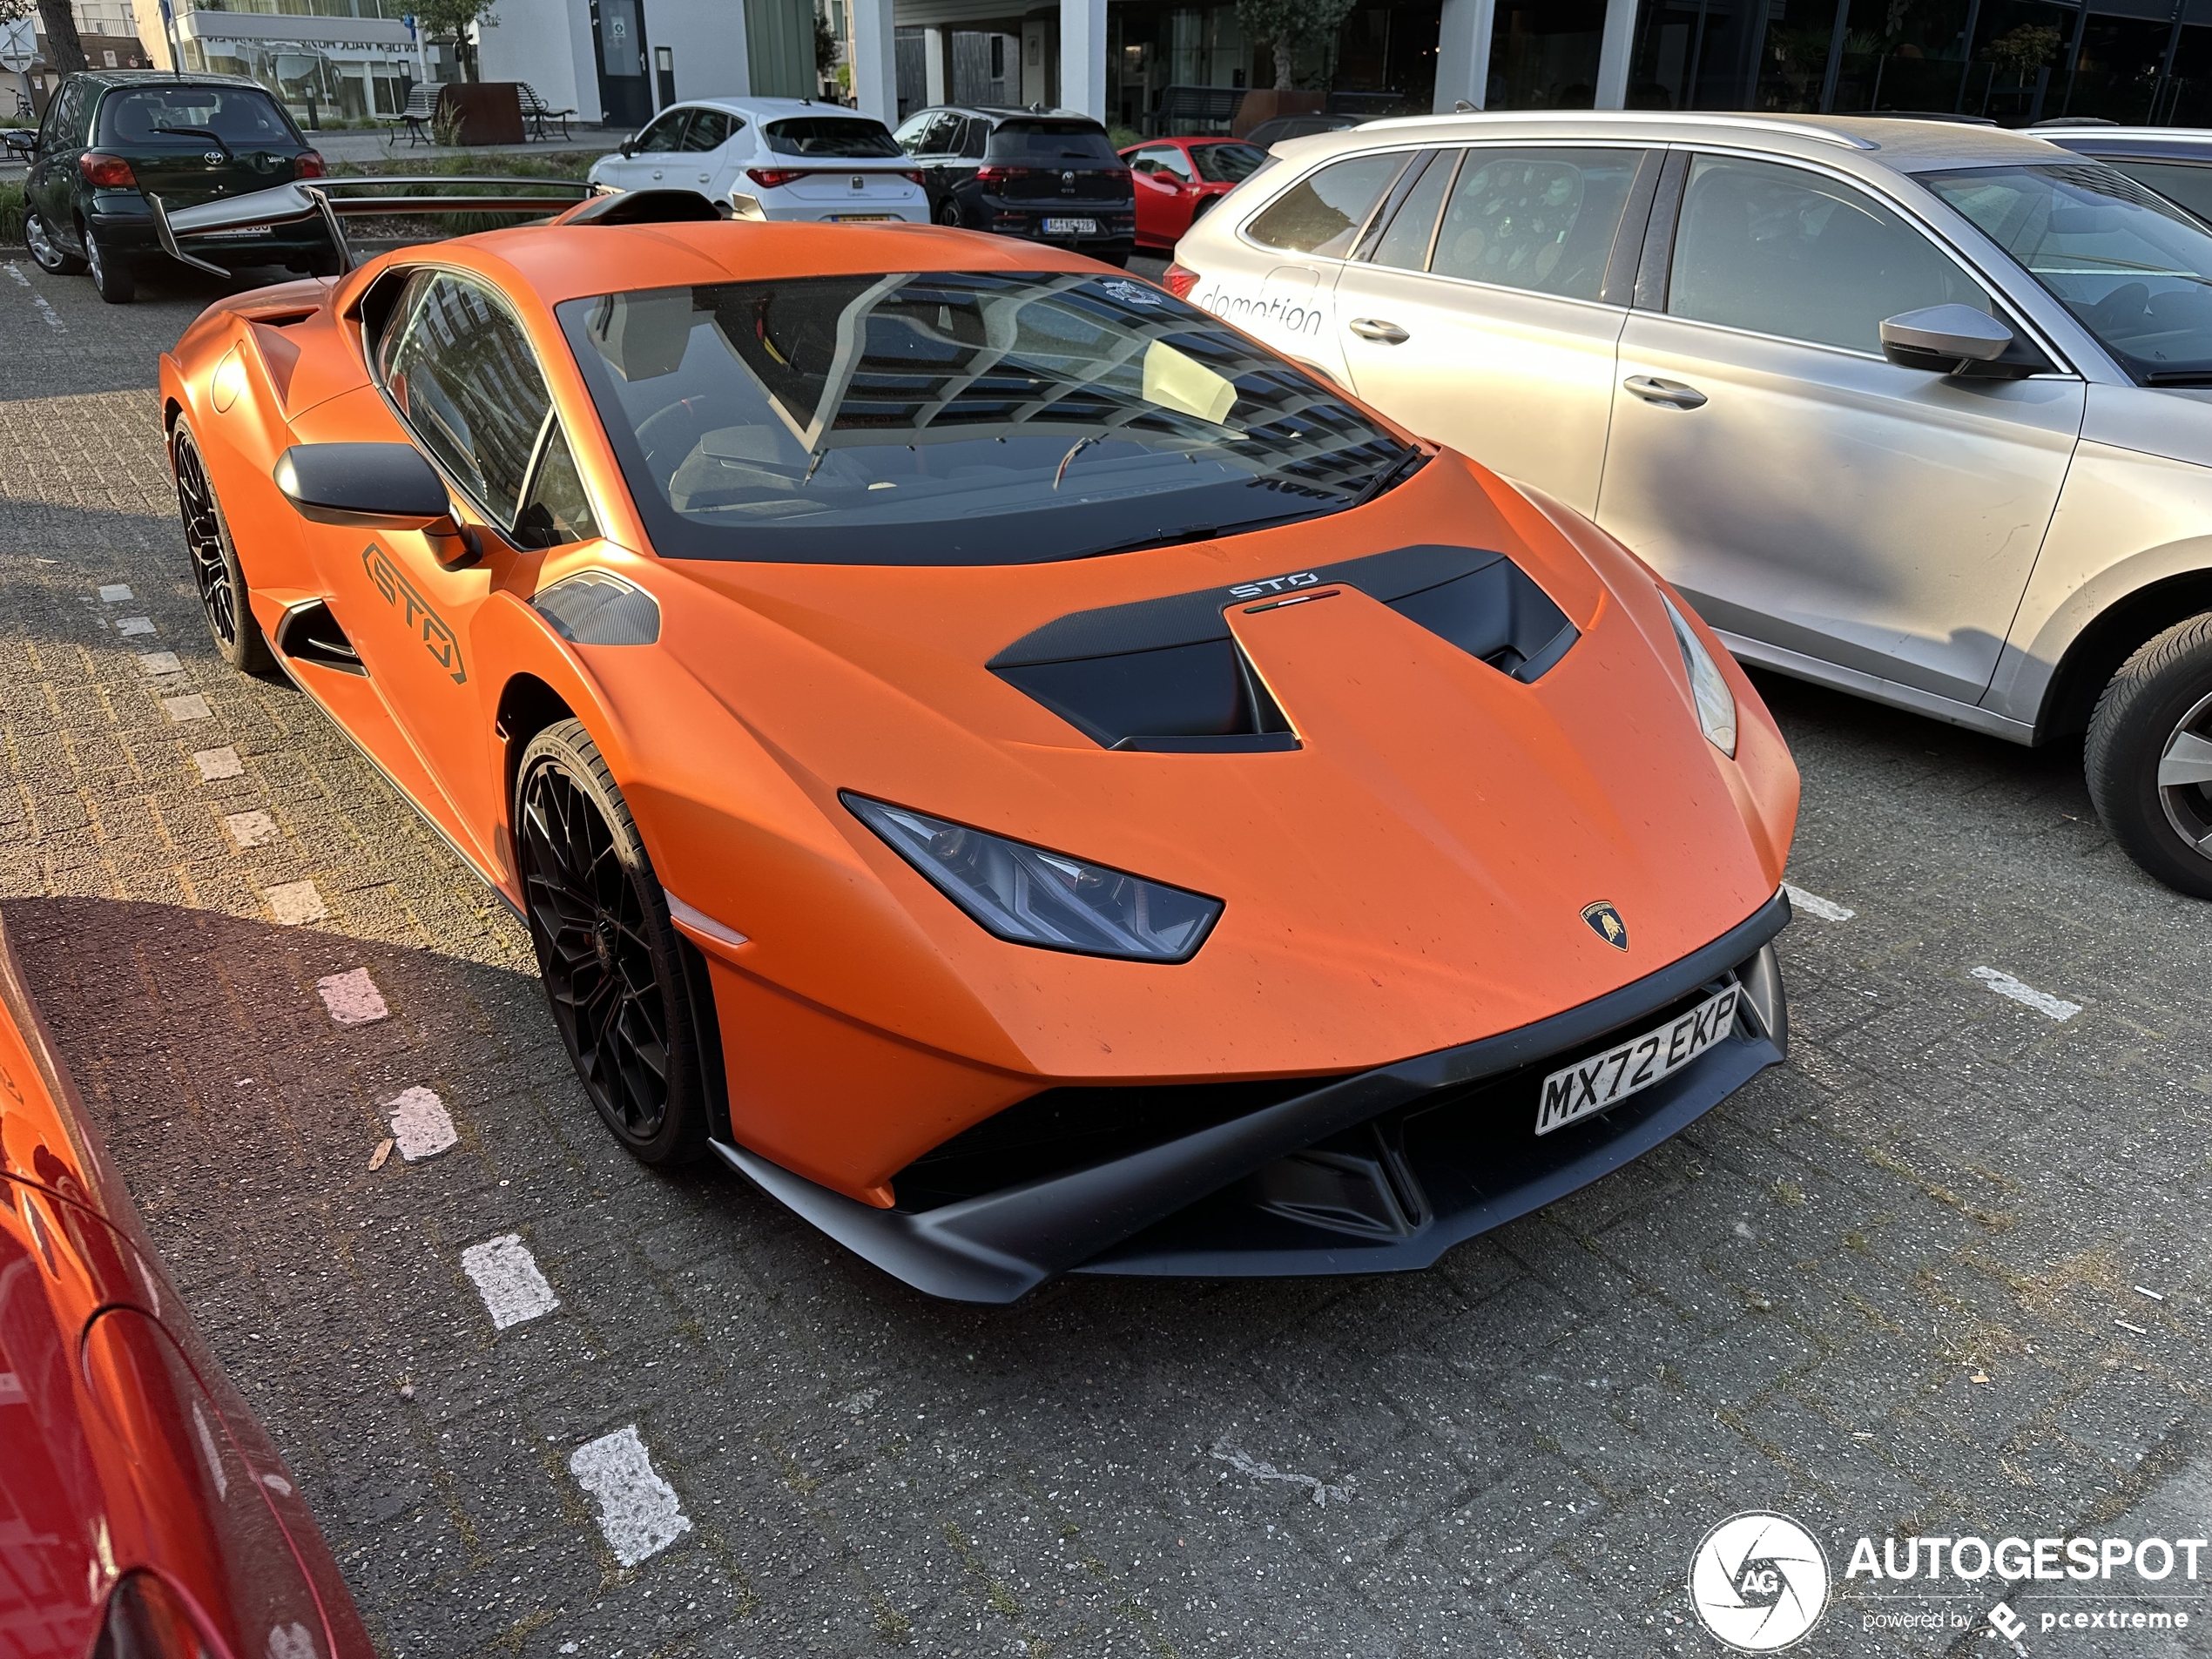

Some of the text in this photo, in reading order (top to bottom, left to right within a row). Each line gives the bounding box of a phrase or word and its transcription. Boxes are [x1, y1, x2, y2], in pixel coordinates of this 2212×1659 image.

[1201, 285, 1321, 336] domotion
[374, 556, 451, 668] STO
[1229, 572, 1318, 598] STO
[1541, 991, 1736, 1128] MX72 EKP
